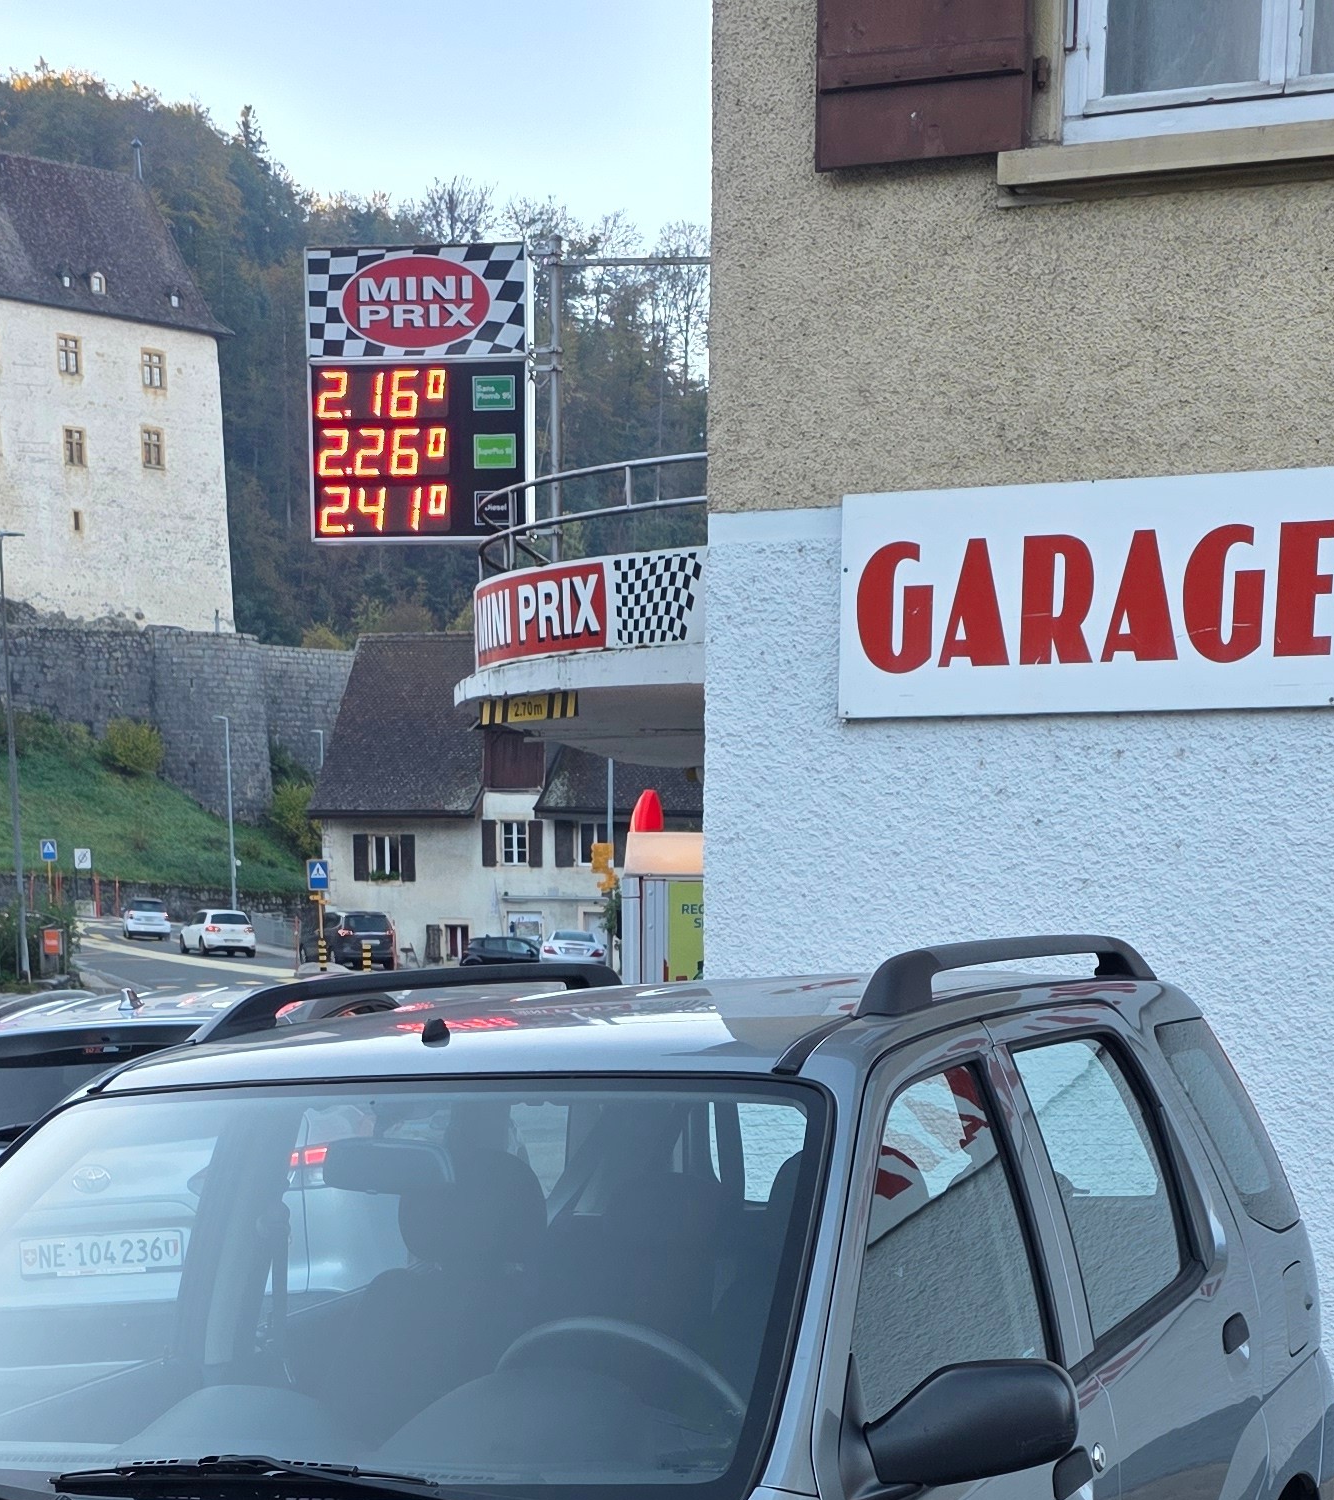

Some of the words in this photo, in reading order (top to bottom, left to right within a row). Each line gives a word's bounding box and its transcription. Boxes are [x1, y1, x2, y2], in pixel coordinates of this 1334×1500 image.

[358, 275, 473, 301] MINI
[358, 303, 475, 328] PRIX
[477, 588, 512, 652] MINI
[518, 573, 601, 643] PRIX
